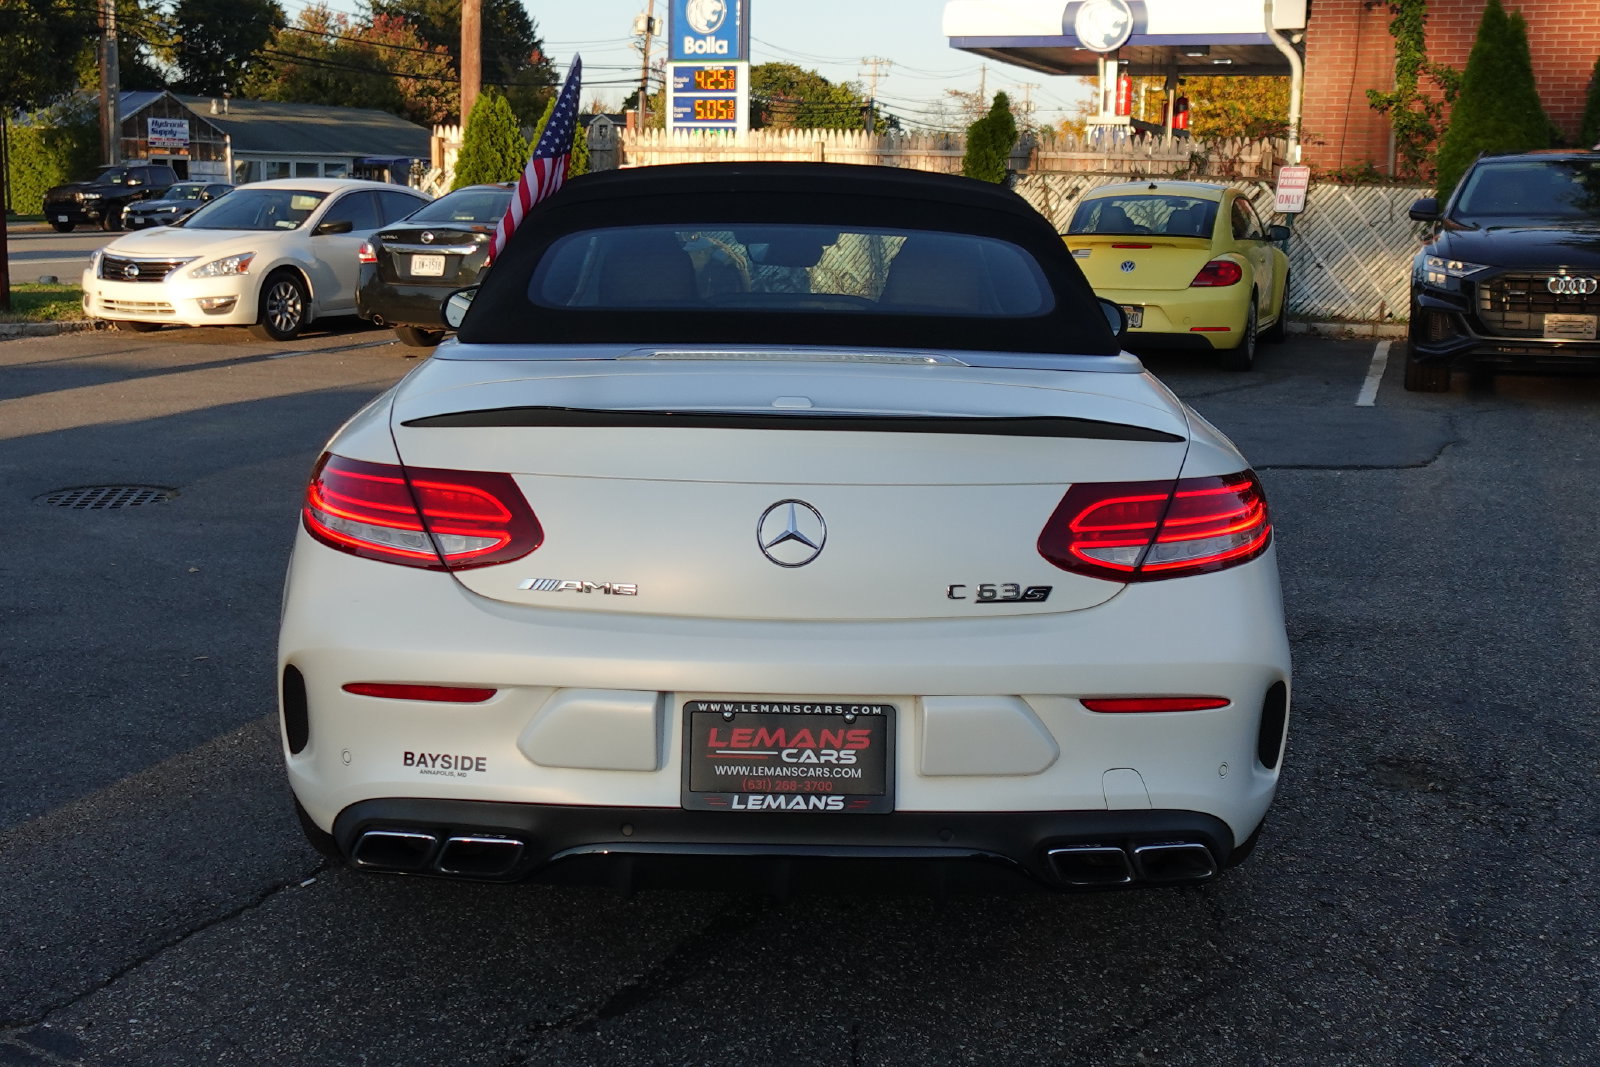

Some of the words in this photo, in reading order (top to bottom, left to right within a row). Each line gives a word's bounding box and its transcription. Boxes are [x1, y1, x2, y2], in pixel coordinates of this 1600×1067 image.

[683, 36, 729, 54] Bolla
[694, 70, 727, 90] 4.25
[694, 99, 727, 120] 5.05
[151, 119, 185, 128] Hydronic
[151, 128, 178, 137] Supply
[1278, 194, 1303, 204] ONLY
[558, 580, 638, 596] AMG
[946, 584, 967, 600] C
[697, 703, 882, 715] WWW.LEMANSCARS.COM
[707, 727, 872, 750] LEMANS
[403, 751, 487, 772] BAYSIDE
[781, 749, 858, 764] CARS
[419, 769, 456, 778] ANNAPOLIS,
[714, 765, 862, 779] WWW.LEMANSCARS.COM
[742, 778, 772, 791] (631)
[731, 794, 845, 810] LEMANS
